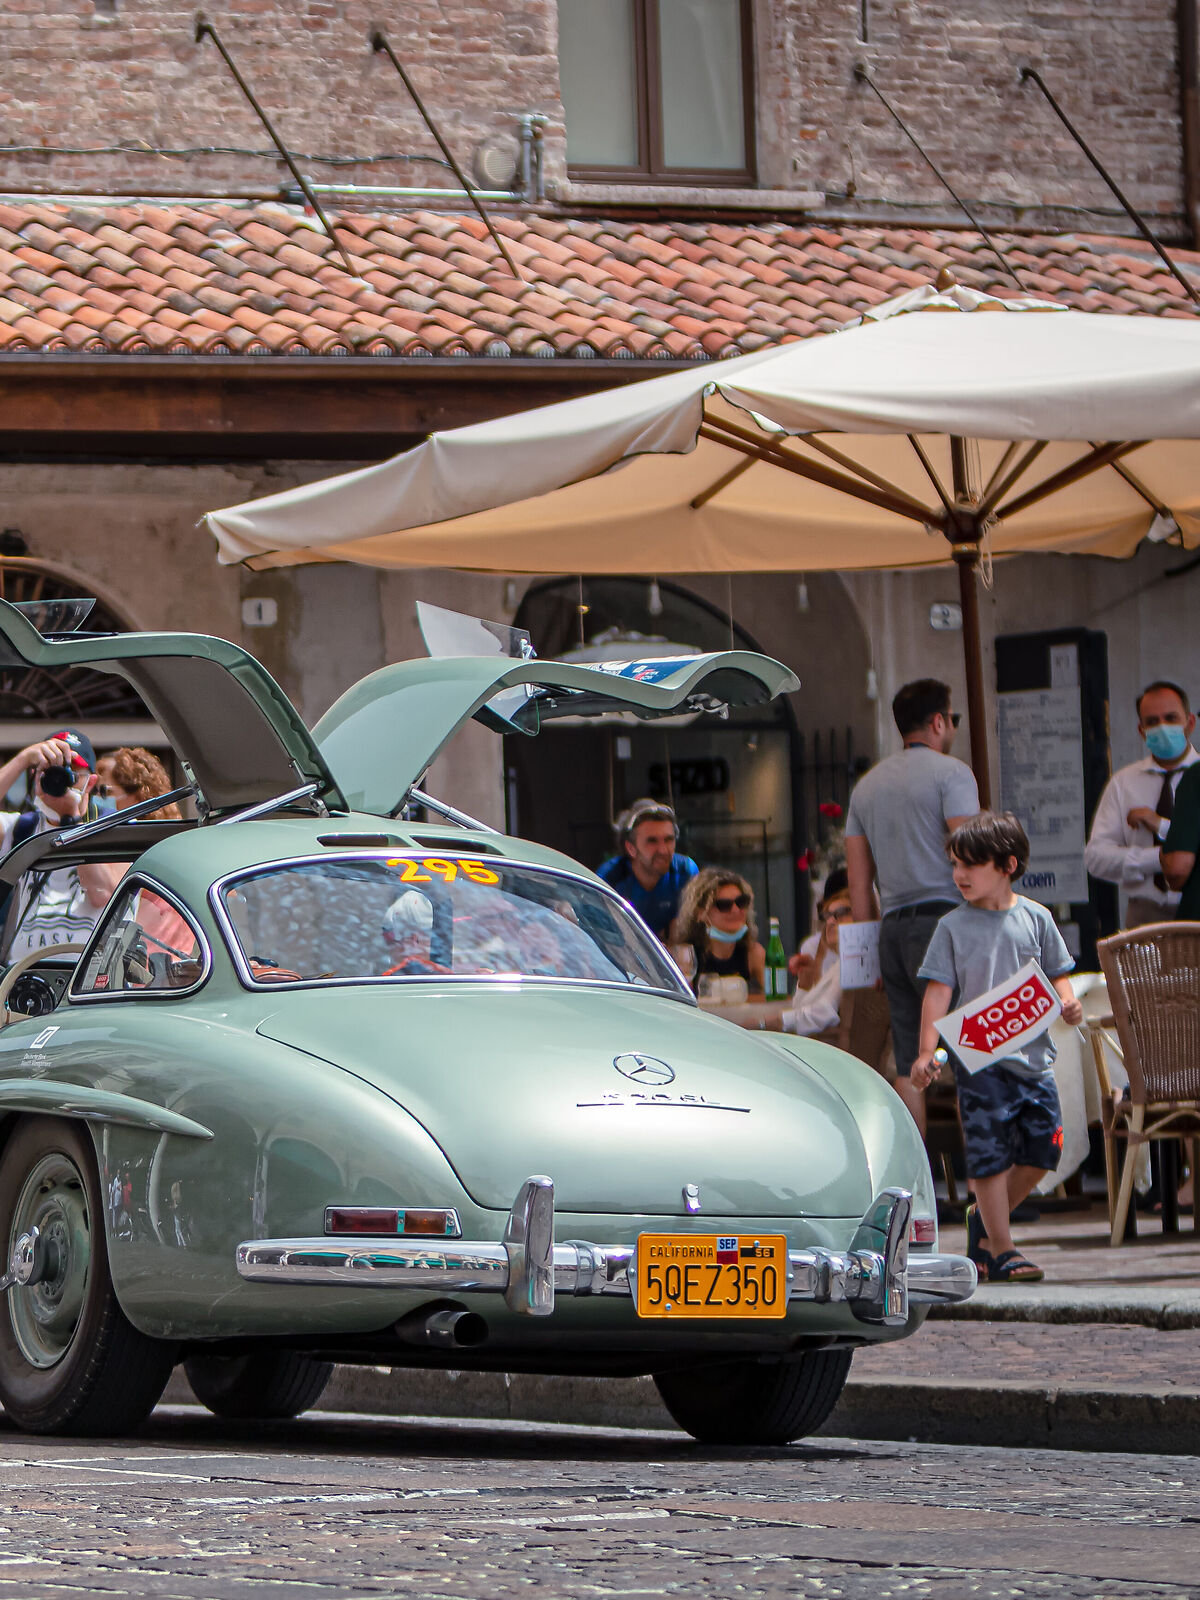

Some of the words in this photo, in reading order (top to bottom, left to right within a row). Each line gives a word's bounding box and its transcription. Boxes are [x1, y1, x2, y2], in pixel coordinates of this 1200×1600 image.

[386, 857, 500, 884] 295
[27, 933, 75, 948] EASY
[976, 984, 1036, 1030] 1000
[985, 996, 1052, 1048] MIGLIA
[650, 1245, 714, 1258] CALIFORNIA
[719, 1238, 737, 1250] SEP
[754, 1247, 771, 1258] 56
[647, 1264, 778, 1306] 5QEZ350
